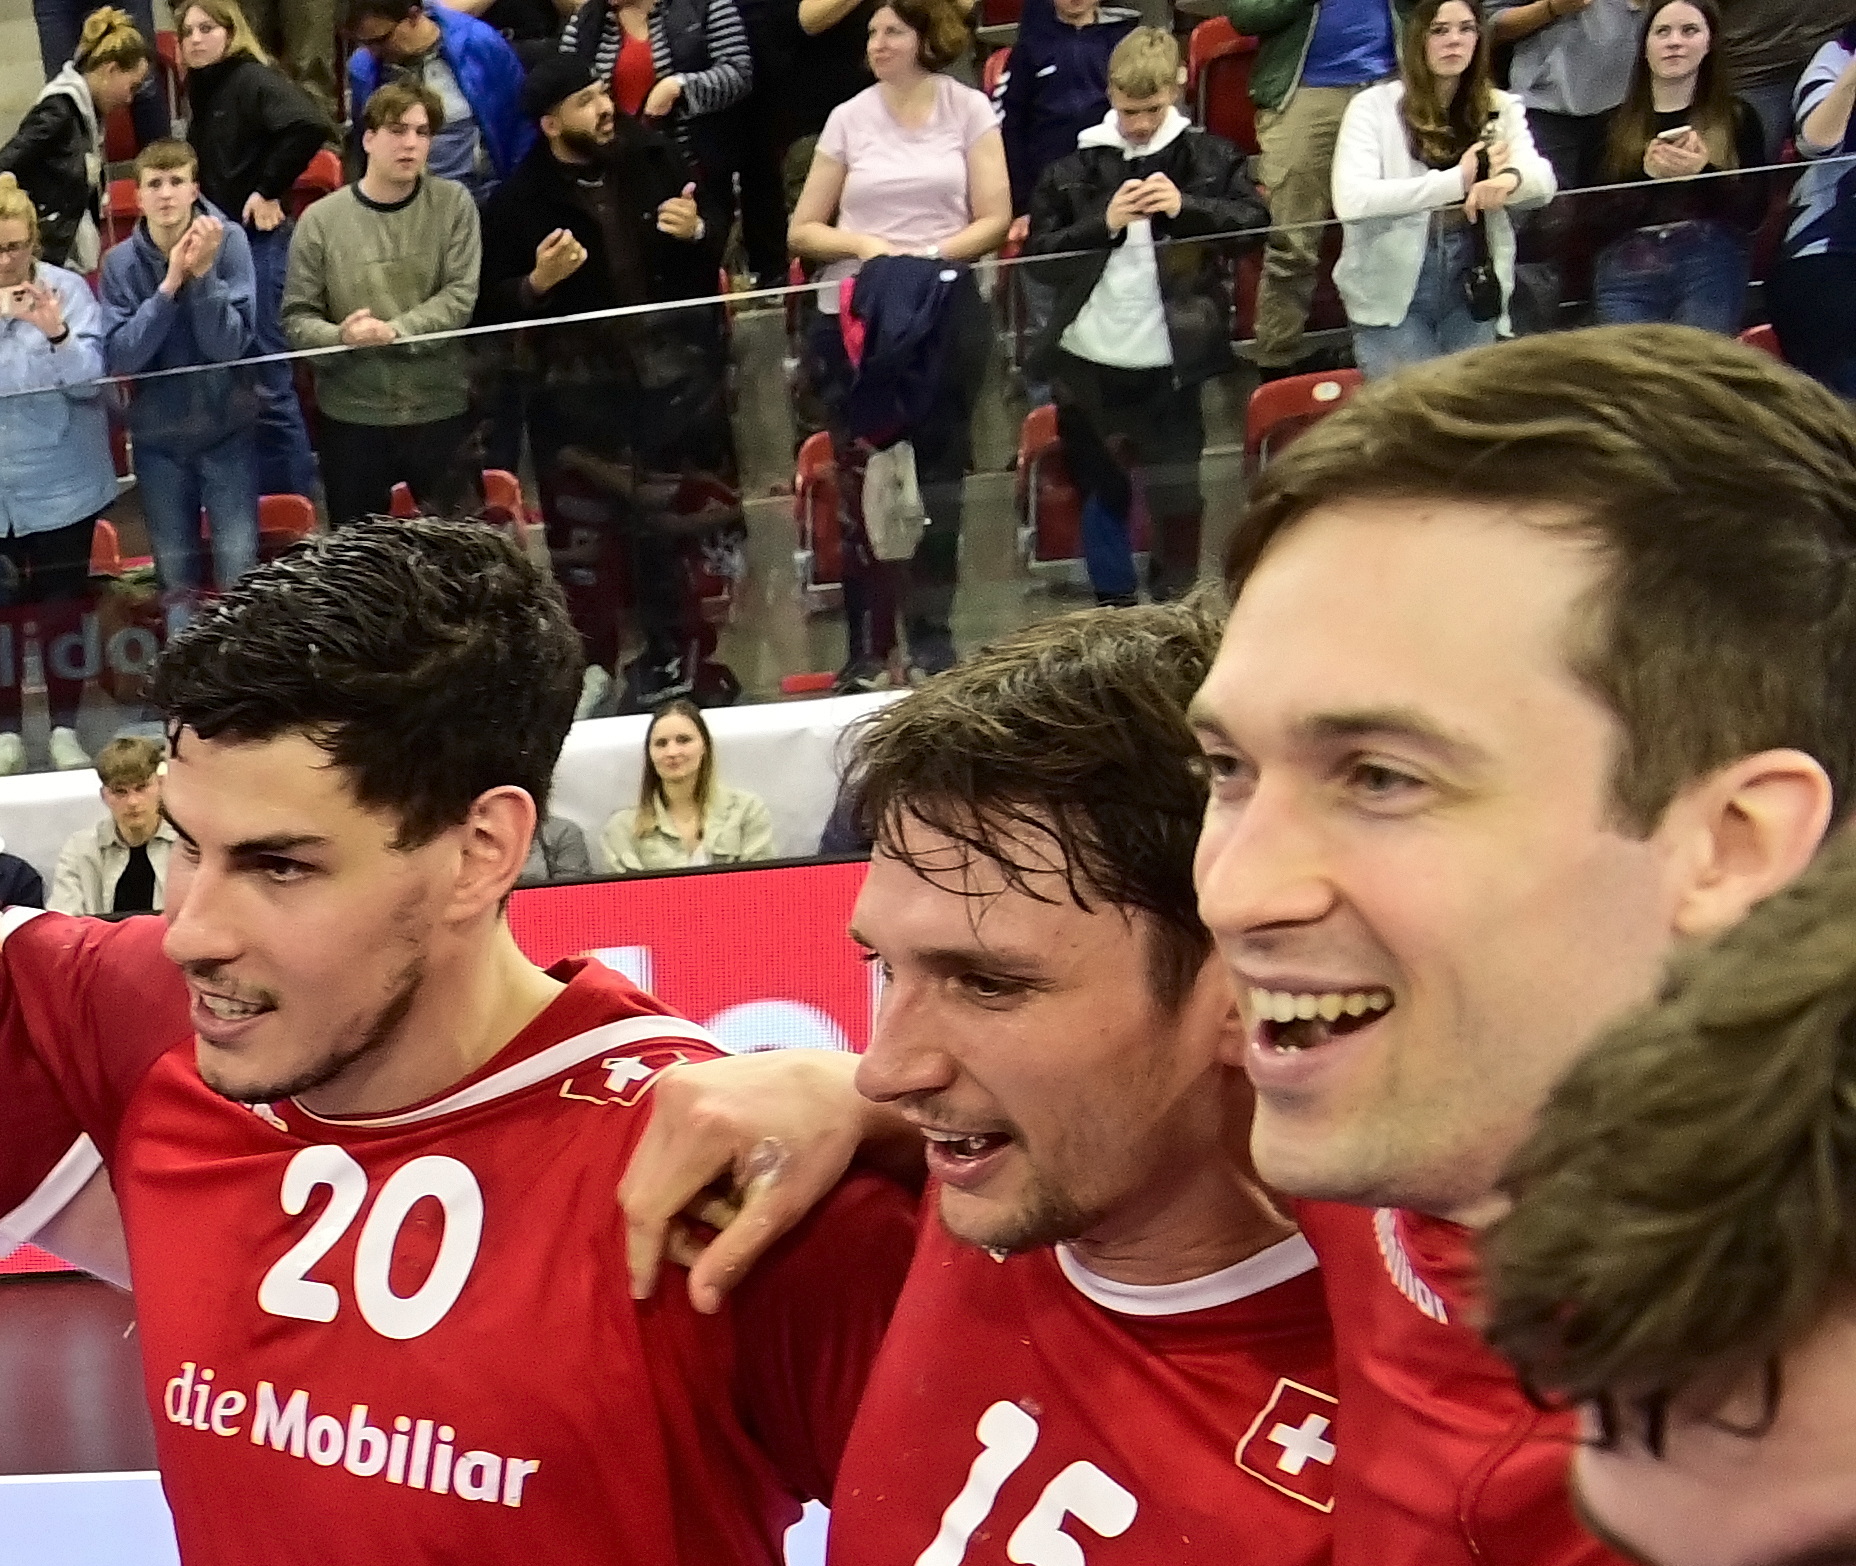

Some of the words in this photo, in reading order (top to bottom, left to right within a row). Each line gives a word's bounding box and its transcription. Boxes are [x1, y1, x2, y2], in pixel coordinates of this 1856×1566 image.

[257, 1144, 484, 1340] 20
[164, 1361, 247, 1437] die
[250, 1380, 541, 1508] Mobiliar
